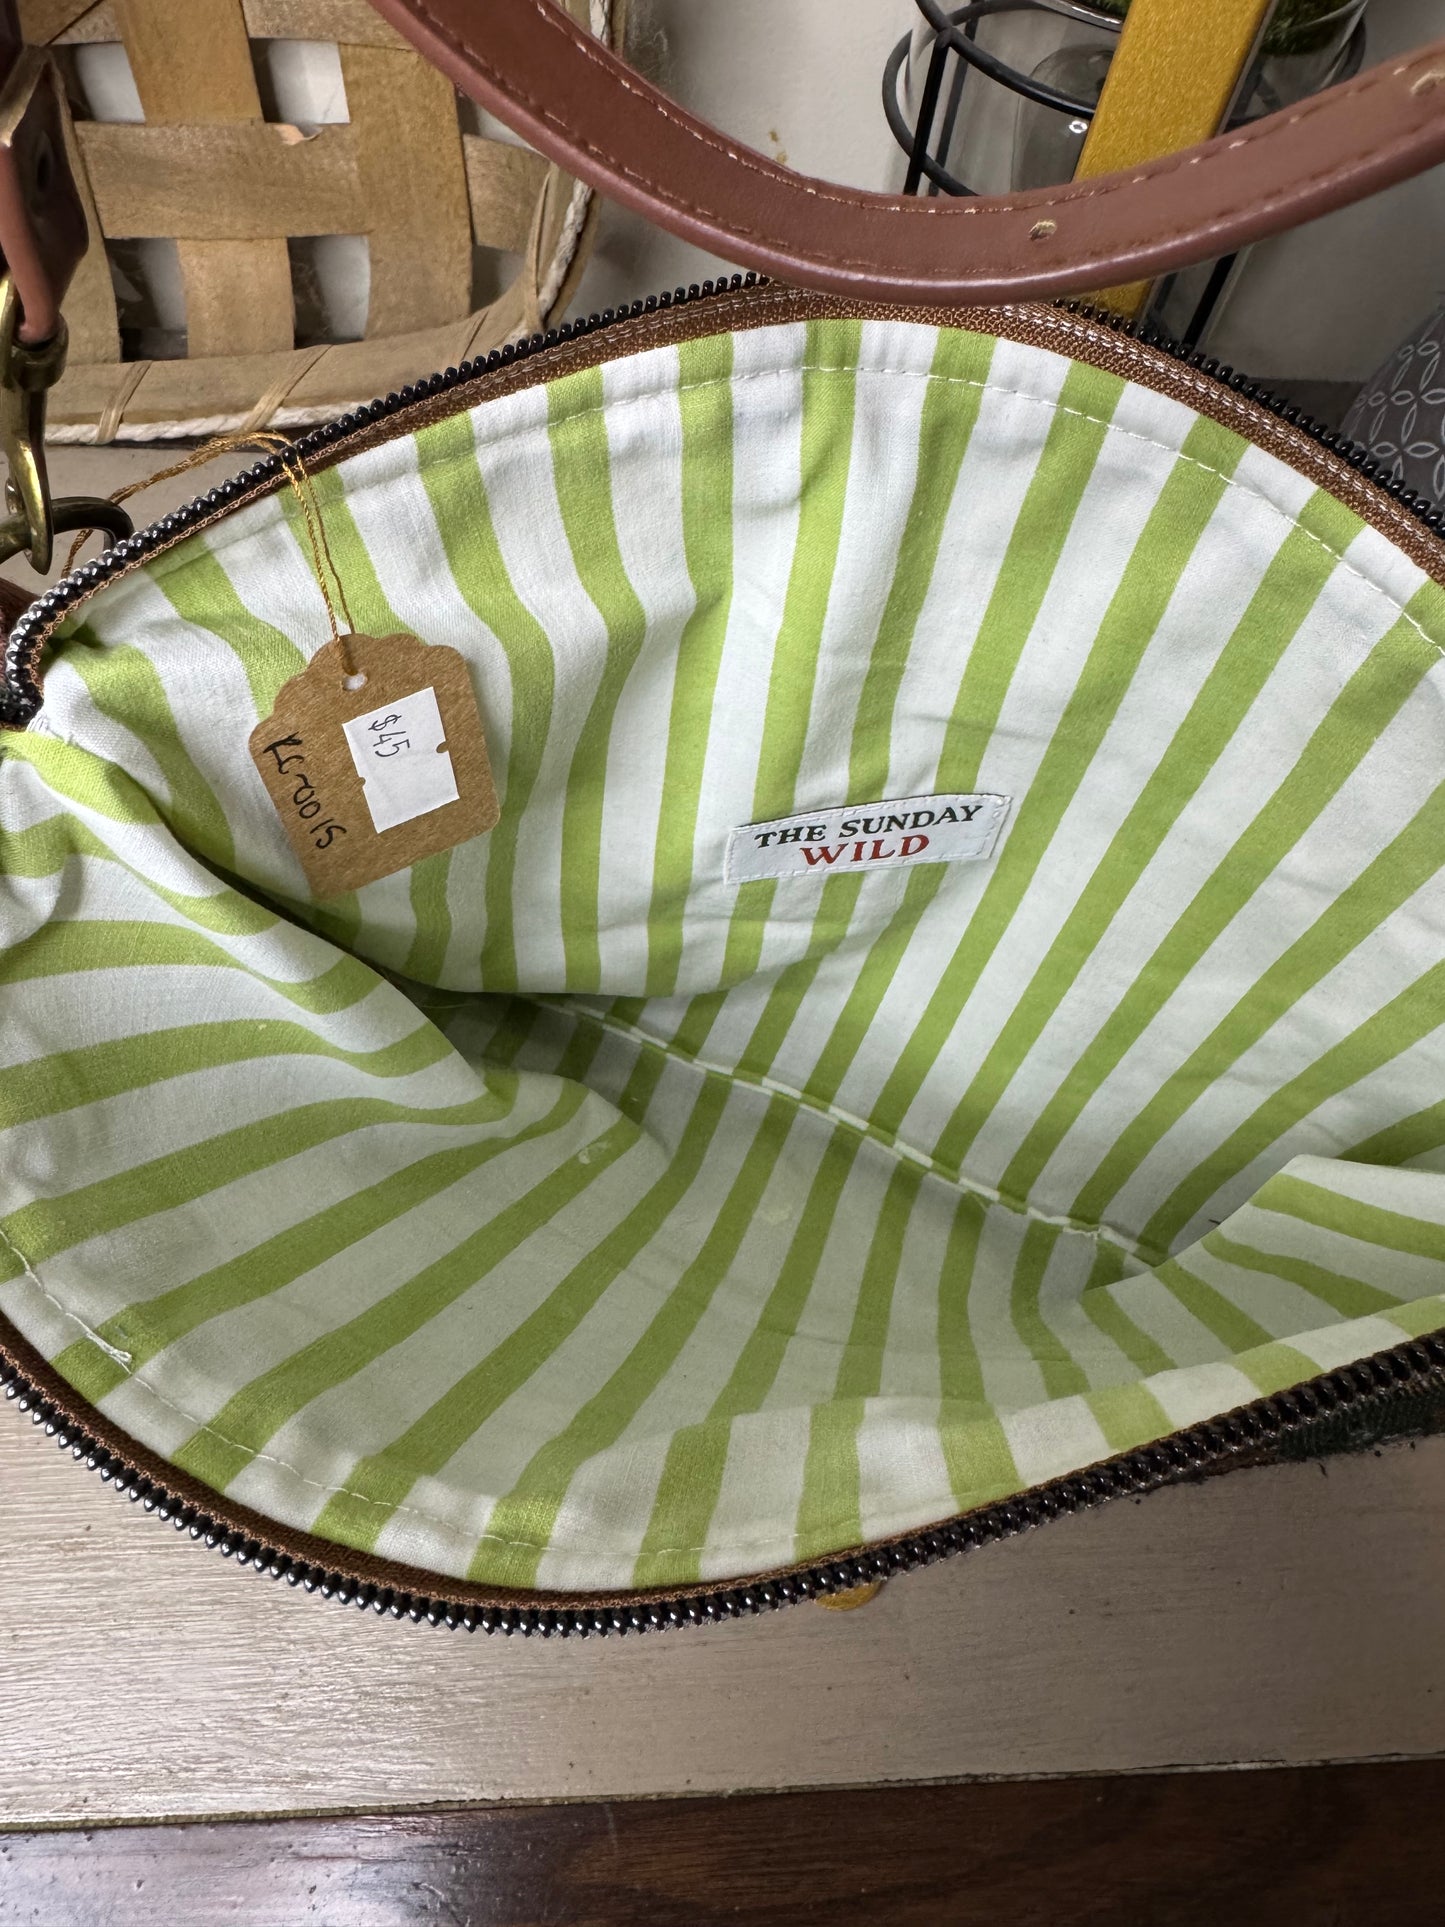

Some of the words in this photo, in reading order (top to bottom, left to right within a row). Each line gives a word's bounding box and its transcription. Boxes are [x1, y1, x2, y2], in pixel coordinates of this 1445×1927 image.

[368, 714, 411, 757] $45
[754, 824, 826, 849] THE
[838, 805, 983, 838] SUNDAY
[800, 834, 930, 866] WILD
